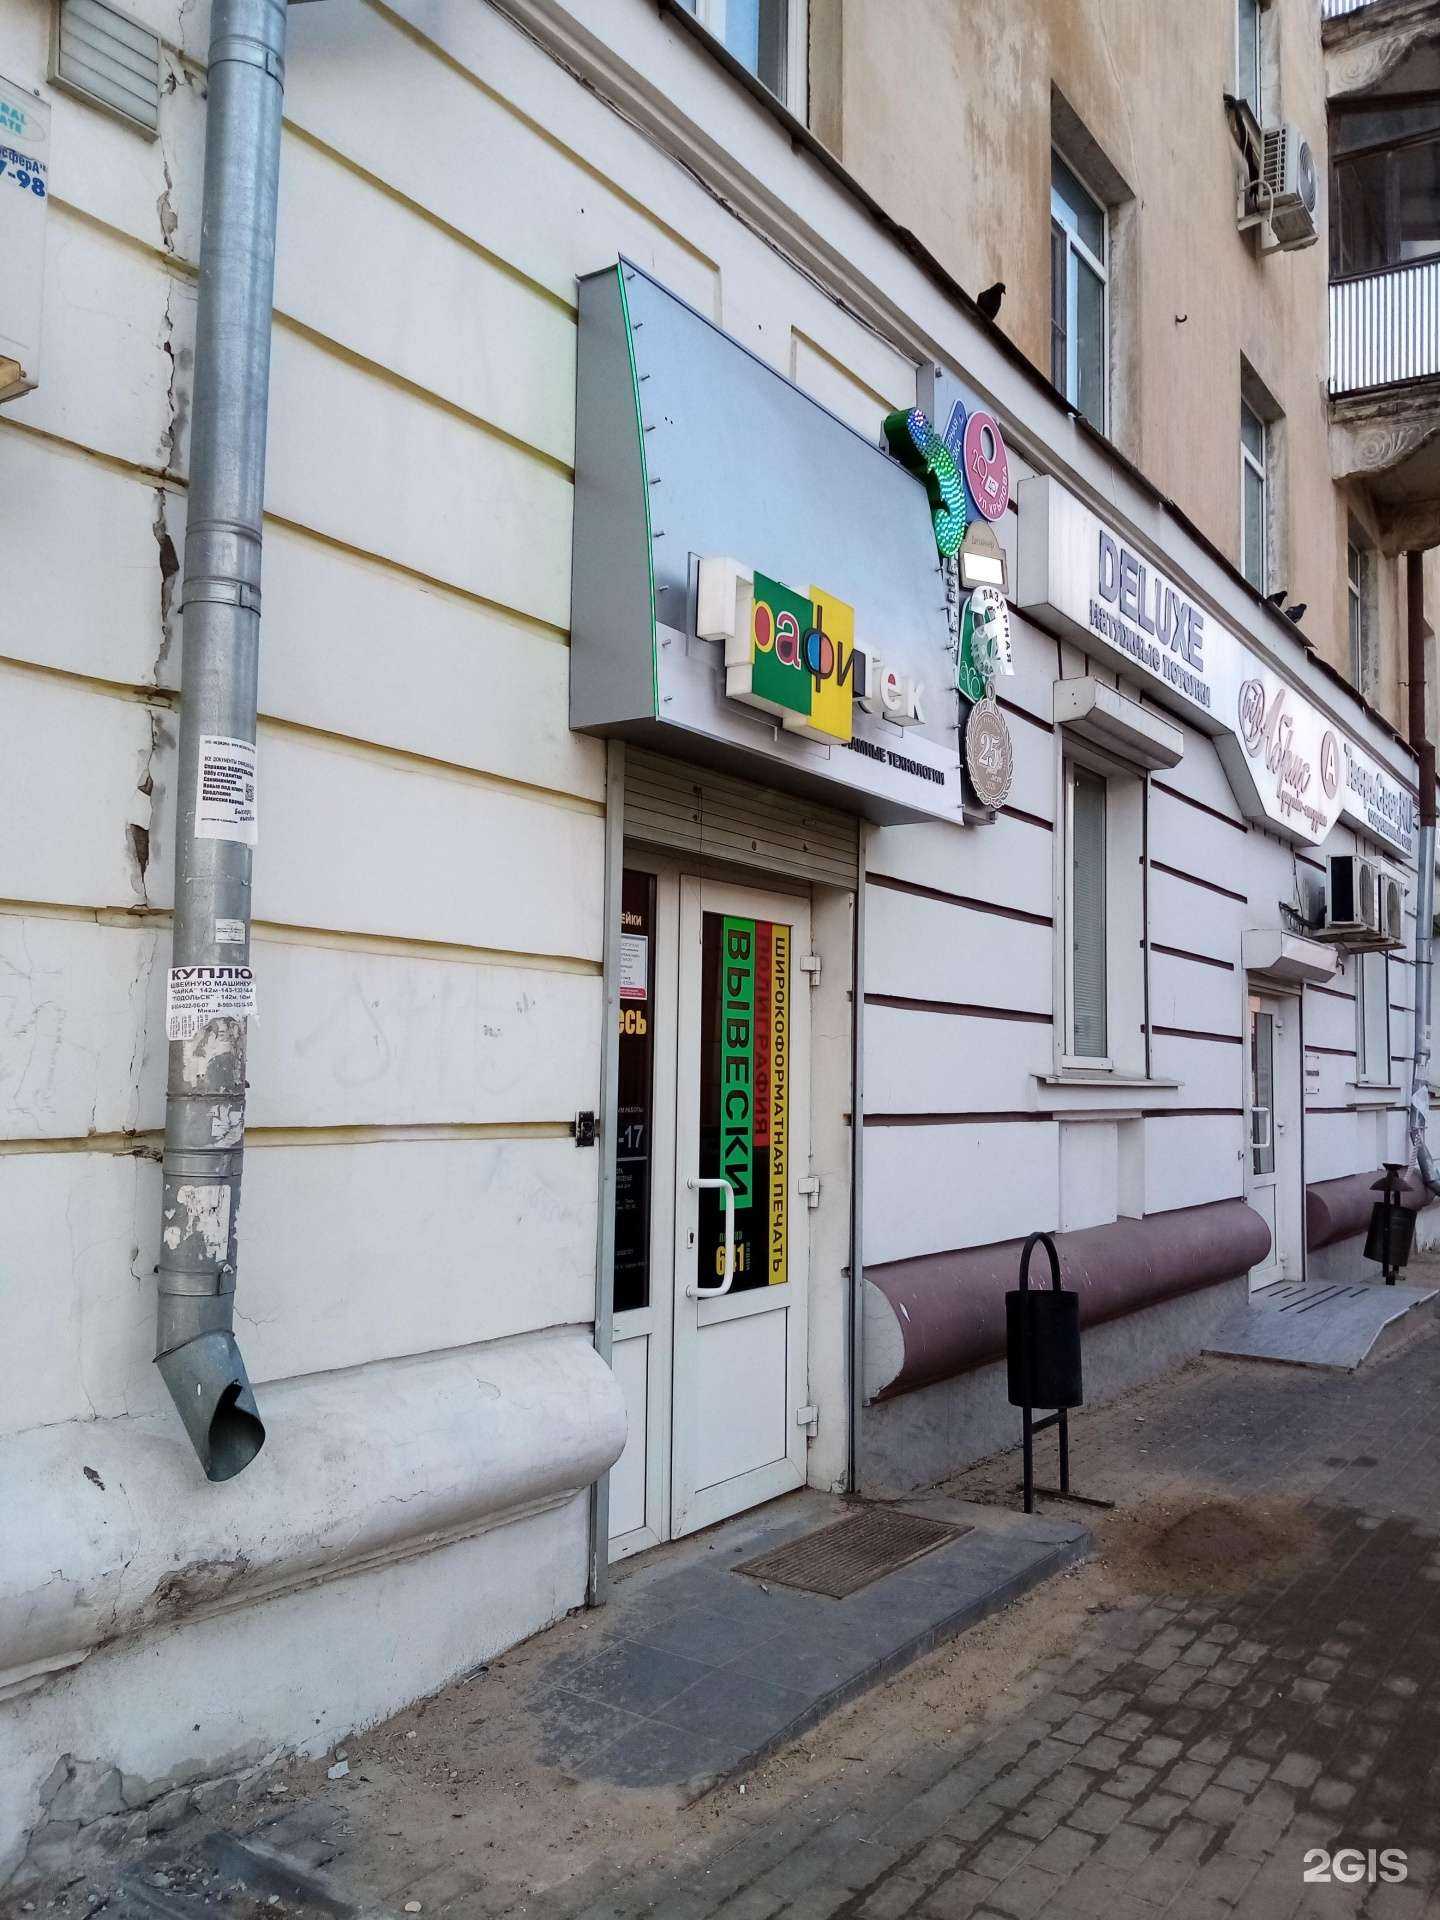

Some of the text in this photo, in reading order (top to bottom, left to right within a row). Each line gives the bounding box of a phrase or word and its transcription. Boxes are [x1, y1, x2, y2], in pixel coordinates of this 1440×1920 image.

[1098, 529, 1204, 673] DELUXE
[886, 750, 945, 786] ТЕХНОЛОГИИ
[979, 733, 1002, 769] 25
[171, 967, 253, 981] КУПЛЮ
[725, 928, 751, 1196] ВЫВЕСКИ
[755, 932, 771, 1135] ПОЛИГРАФИЯ
[772, 937, 786, 1273] ШИРОКОФОРМАТНАЯ ПЕЧАТЬ
[715, 1243, 745, 1276] 61
